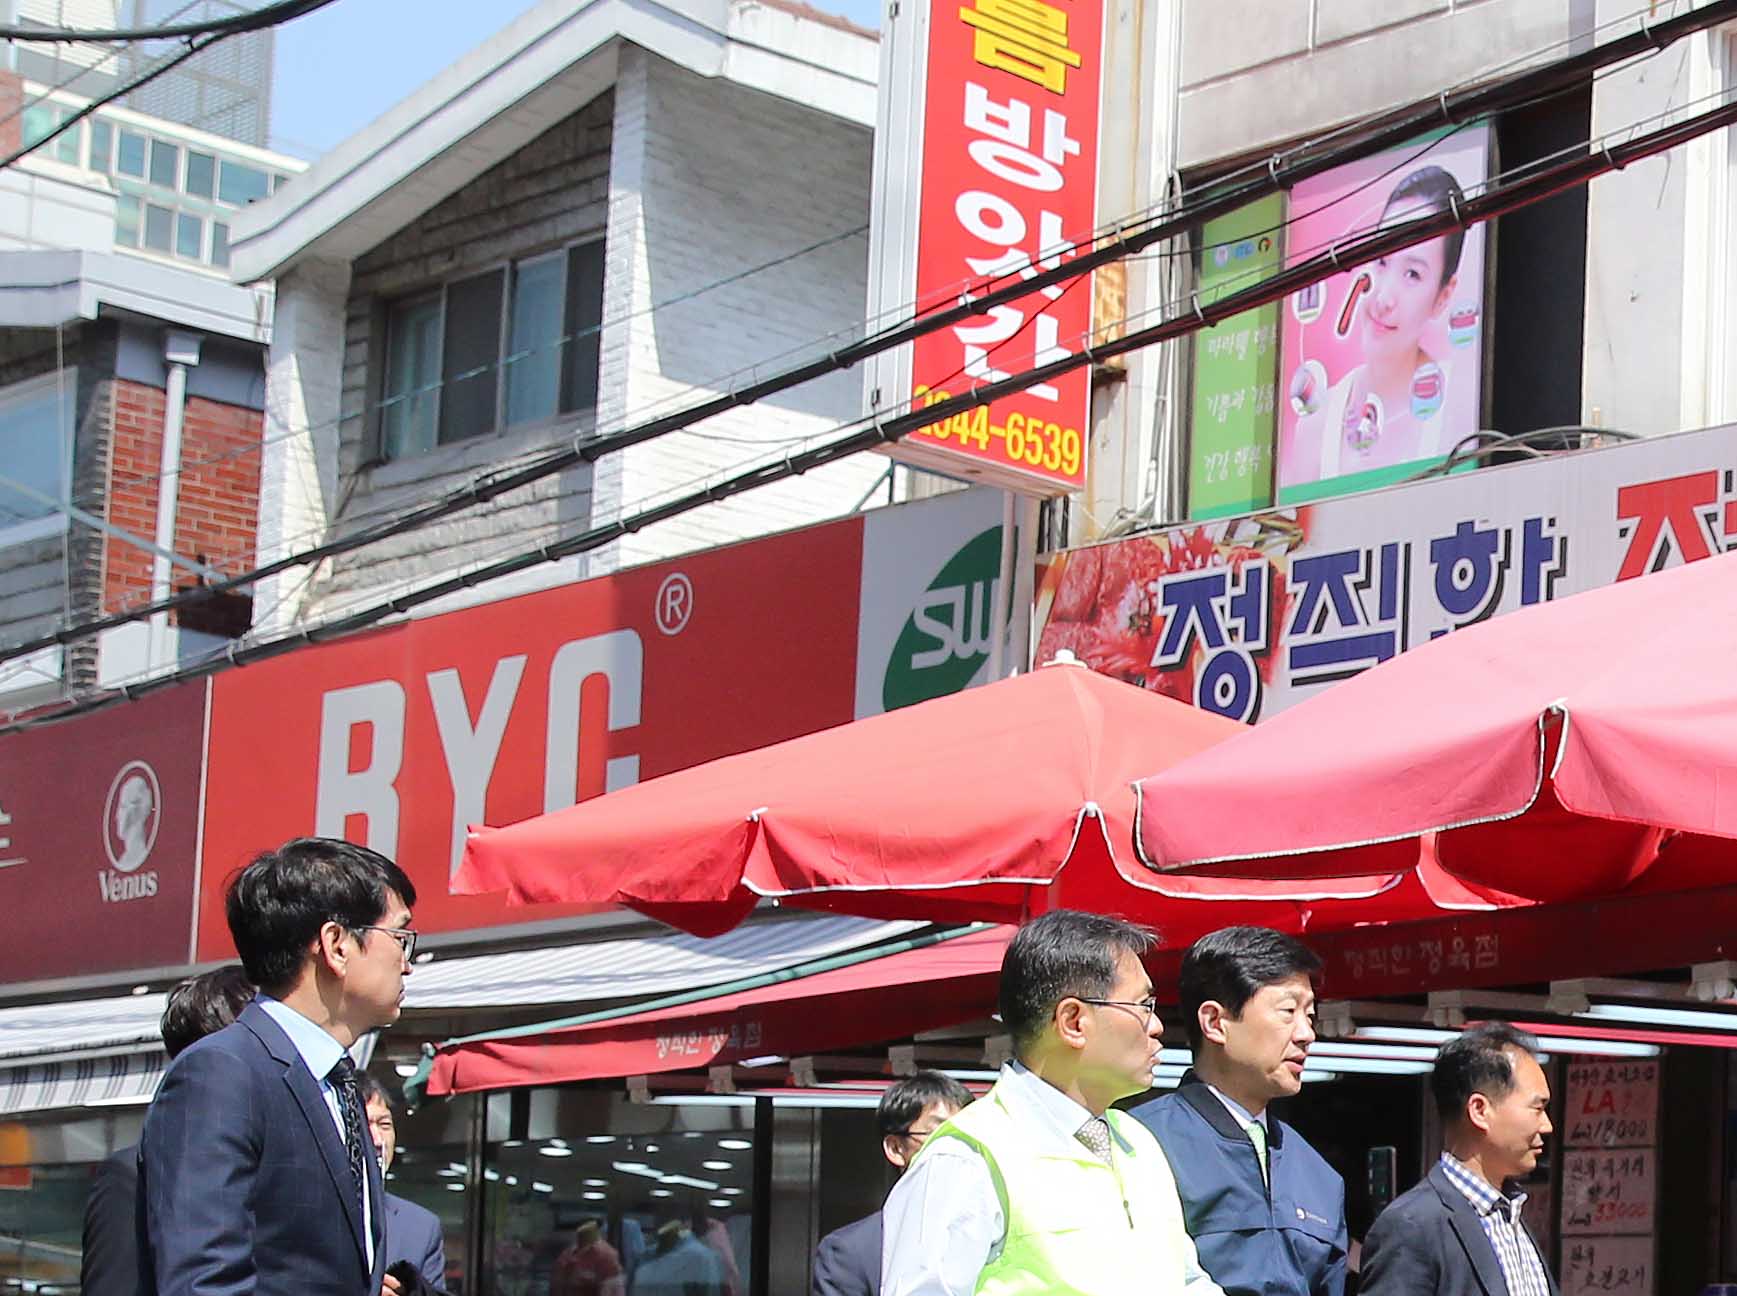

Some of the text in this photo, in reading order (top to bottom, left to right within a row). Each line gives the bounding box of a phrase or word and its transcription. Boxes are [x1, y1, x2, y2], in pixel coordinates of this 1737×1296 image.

[315, 626, 645, 897] BYC
[98, 870, 159, 903] Venus
[1417, 933, 1500, 975] 정육점
